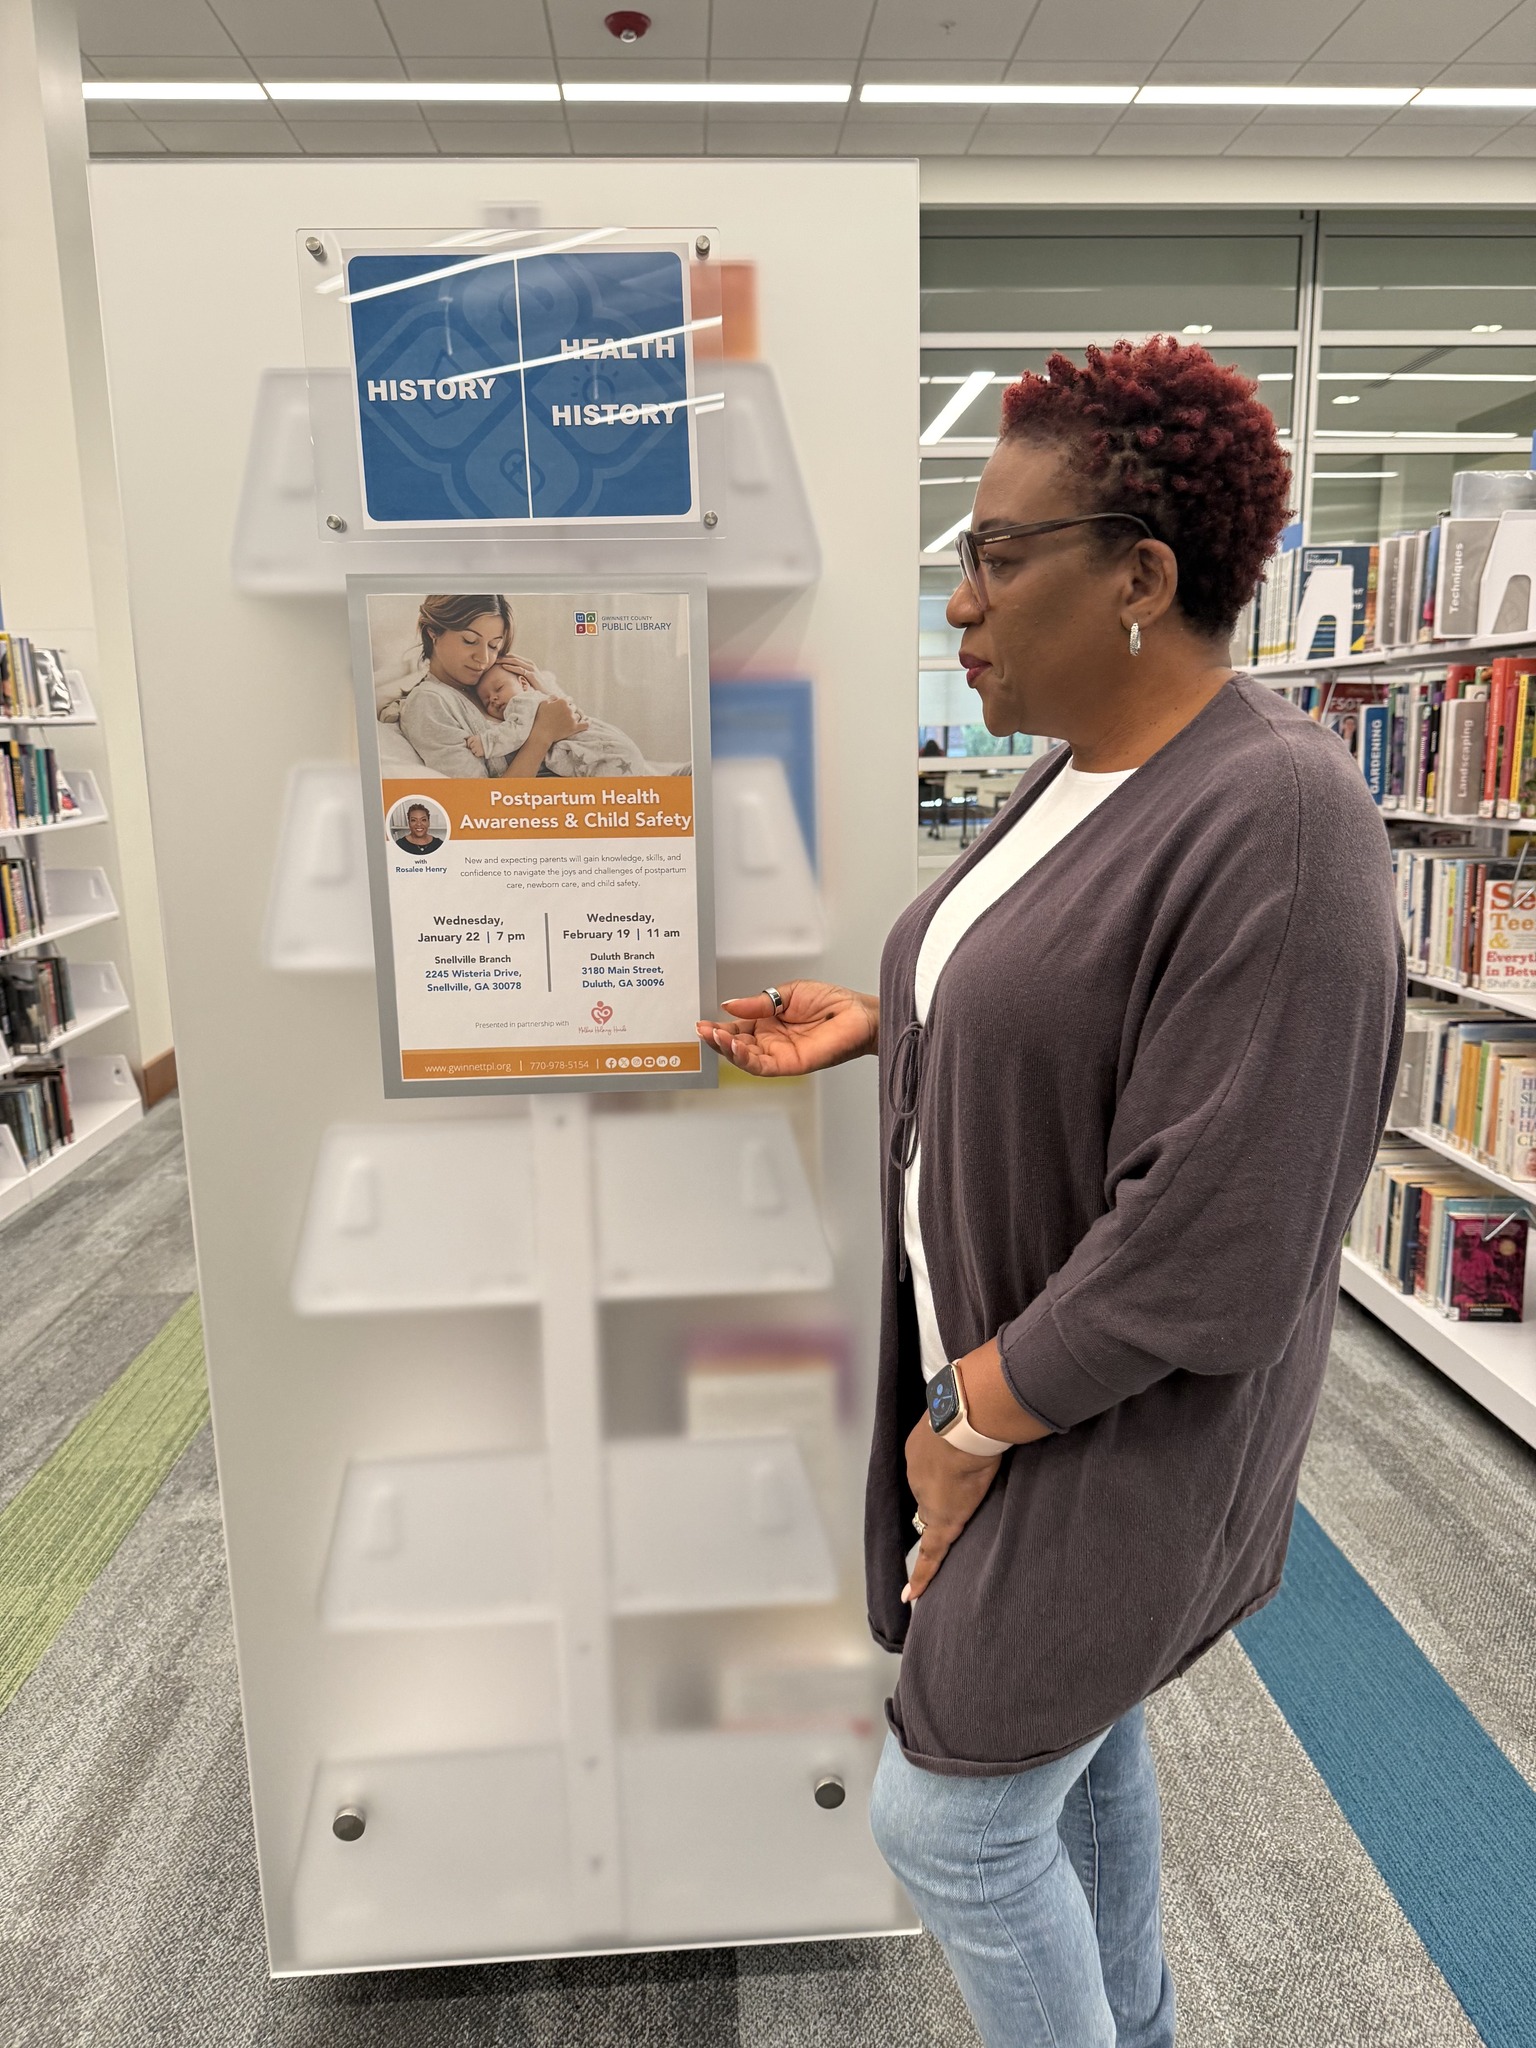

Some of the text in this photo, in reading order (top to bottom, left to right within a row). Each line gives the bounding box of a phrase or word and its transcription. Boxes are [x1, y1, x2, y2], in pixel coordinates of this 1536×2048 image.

[560, 337, 676, 360] HEALTH
[367, 378, 496, 401] HISTORY
[551, 403, 678, 426] HISTORY
[1449, 542, 1464, 614] Techniques
[602, 622, 672, 631] PUBLIC LIBRARY
[1370, 719, 1383, 794] GARDENING
[1458, 719, 1475, 797] Landscaping
[490, 788, 660, 809] Postpartum Health
[459, 810, 693, 831] Awareness & Child Safety
[464, 853, 682, 866] New and expecting parents will gain knowledge, skills, and
[395, 865, 448, 874] Rosalee Henry
[460, 866, 687, 878] confidence to navigate the joys and challenges of postpartum
[506, 879, 641, 890] care, newborn care, and child safety.
[433, 915, 504, 927] Wednesday,
[587, 912, 655, 924] Wednesday,
[418, 932, 462, 944] January
[466, 932, 480, 941] 22
[496, 931, 504, 941] 7
[507, 933, 526, 943] pm
[563, 929, 613, 941] February
[617, 929, 630, 938] 19
[647, 928, 659, 938] 11
[663, 930, 680, 938] am
[1489, 931, 1510, 949] &
[434, 954, 512, 964] Snellville Branch
[590, 951, 655, 961] Duluth Branch
[425, 968, 522, 979] 2245 Wisteria Drive,
[582, 965, 664, 975] 3180 Main Street,
[427, 982, 522, 992] Snellville, GA 30078
[582, 978, 665, 988] Duluth, GA 30096
[475, 1019, 569, 1030] Presented in partnership with
[424, 1060, 589, 1074] www.gwinnettpl.org 770-978-5154
